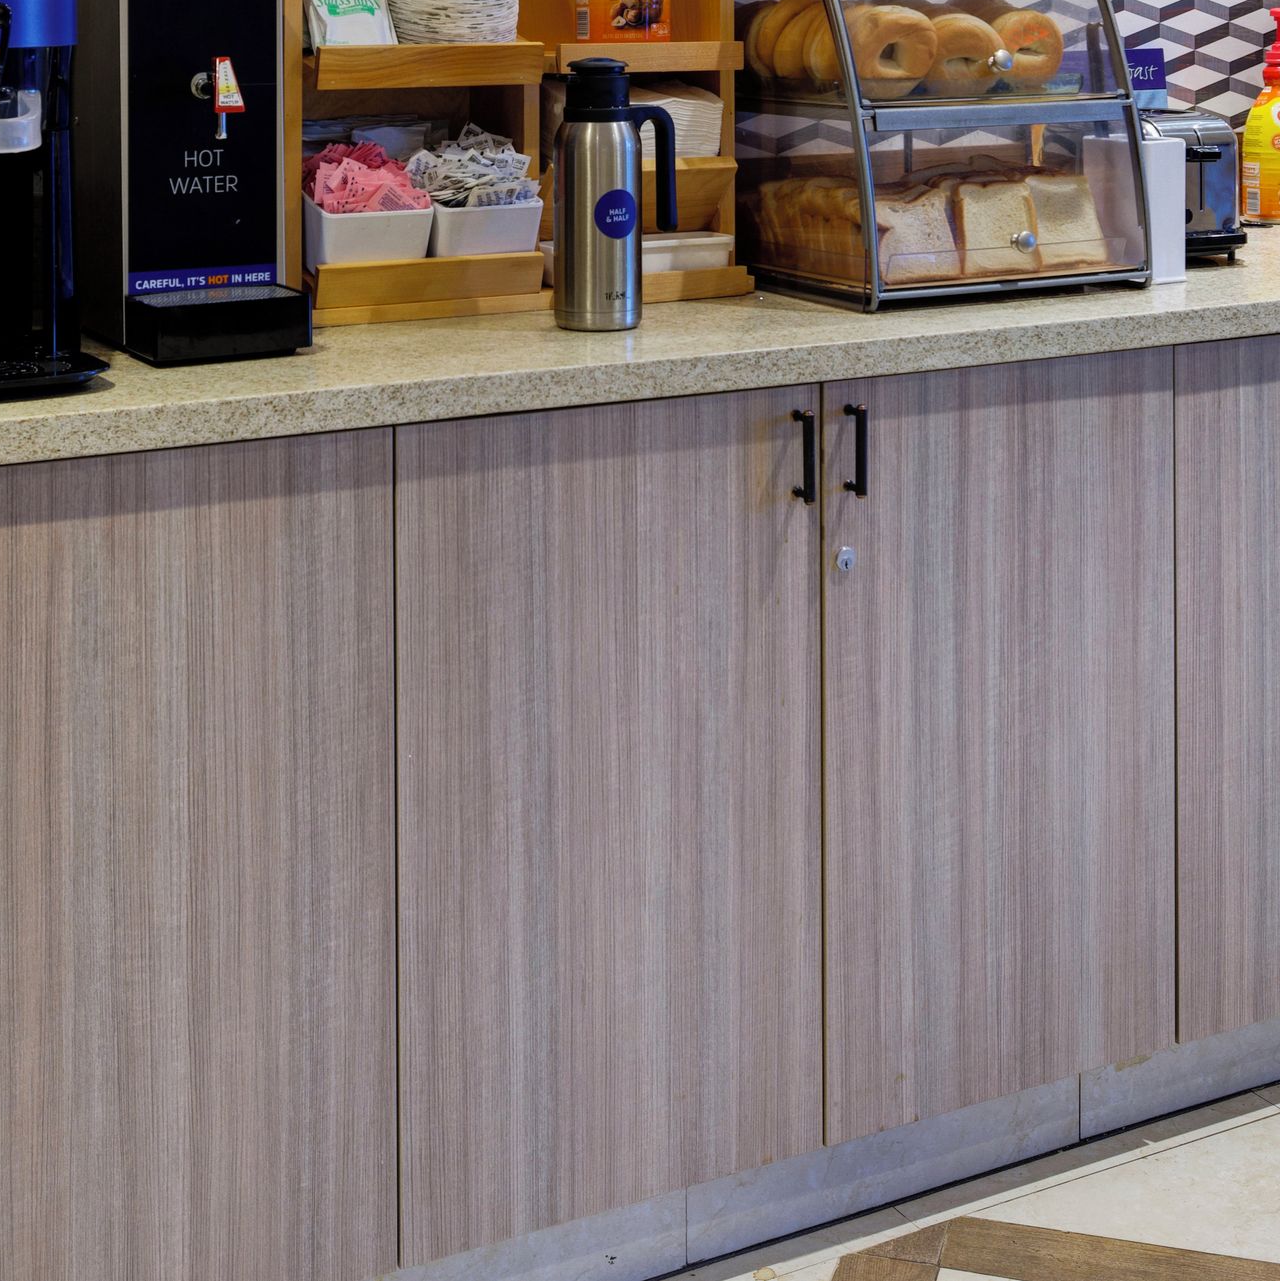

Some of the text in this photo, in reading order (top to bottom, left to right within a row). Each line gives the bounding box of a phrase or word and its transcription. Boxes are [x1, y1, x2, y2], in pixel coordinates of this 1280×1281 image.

[184, 149, 224, 168] HOT
[169, 175, 238, 195] WATER
[609, 207, 626, 216] HALF
[613, 214, 630, 222] HALF
[135, 272, 271, 290] CAREFUL, IT'S HOT IN HERE
